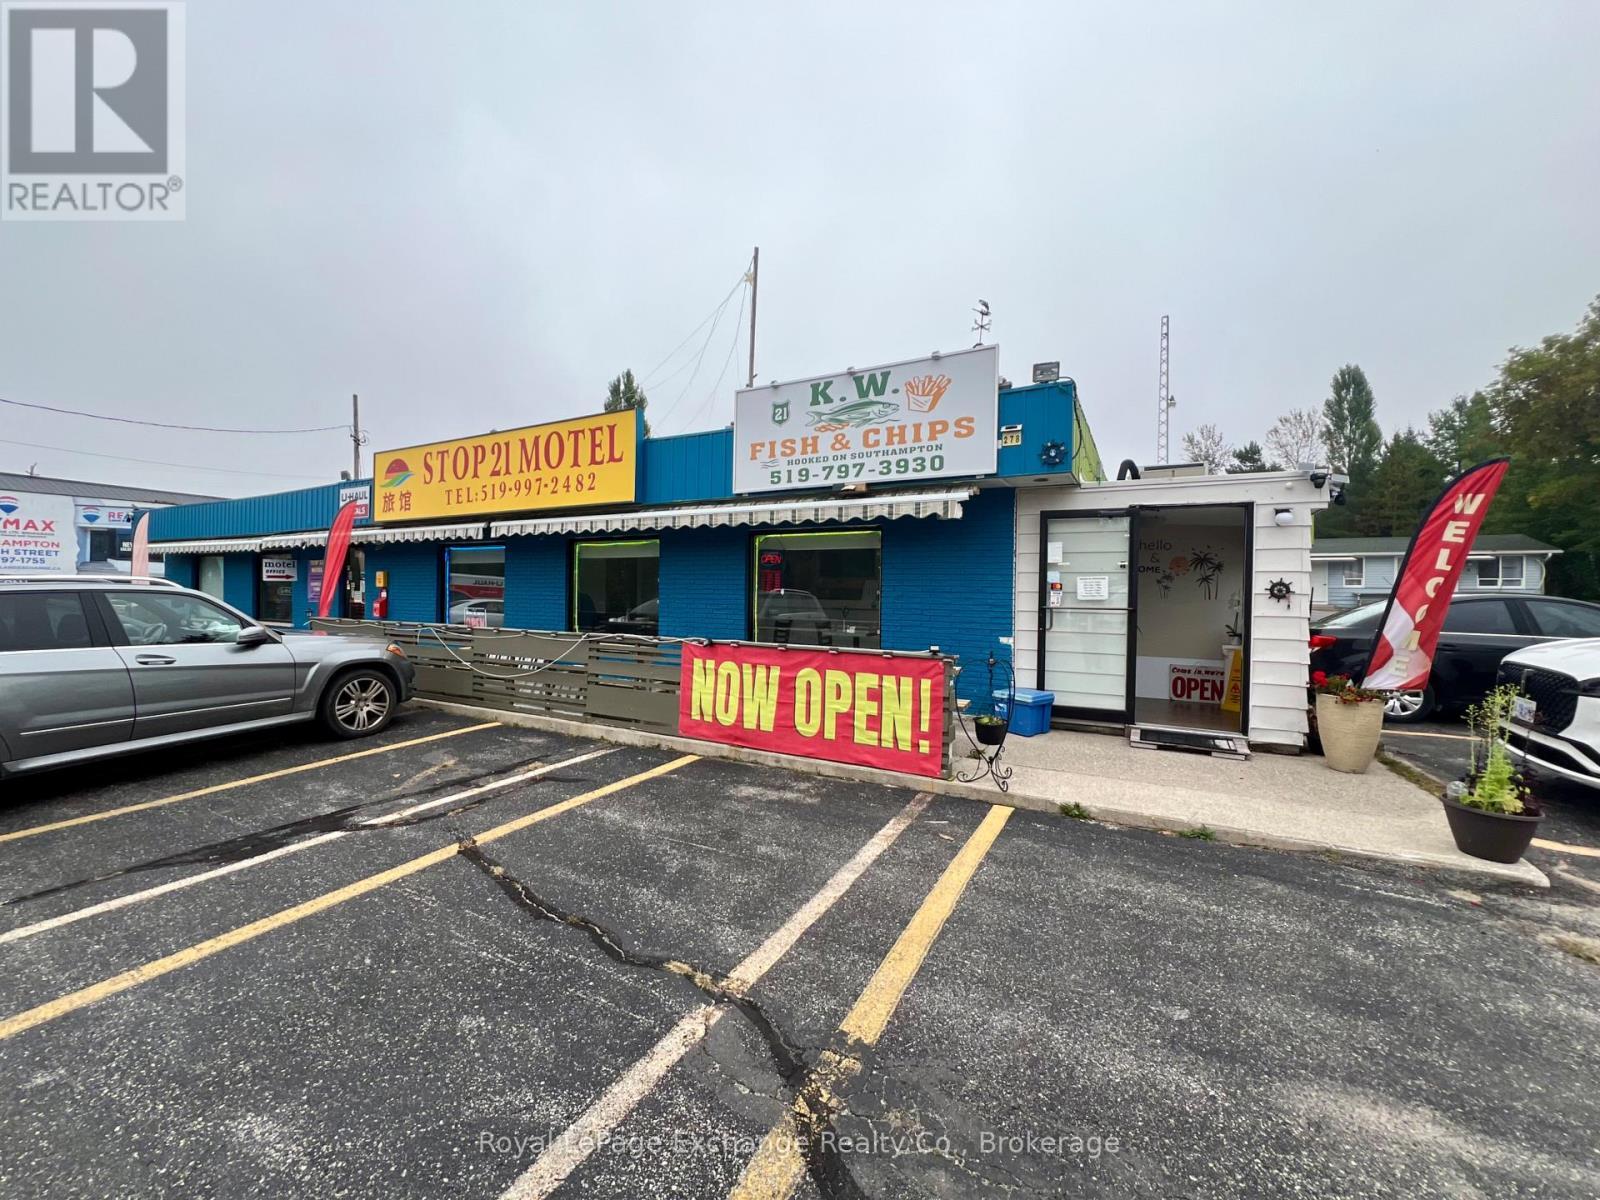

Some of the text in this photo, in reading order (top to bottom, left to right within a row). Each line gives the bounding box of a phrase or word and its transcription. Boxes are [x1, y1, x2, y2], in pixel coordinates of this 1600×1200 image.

[774, 407, 788, 421] 21
[750, 416, 976, 461] FISH & CHIPS
[1003, 434, 1020, 445] 278
[518, 423, 624, 475] MOTEL
[787, 443, 943, 466] HOOKED ON SOUTHAMPTON
[770, 454, 945, 486] 519-797-3930
[341, 490, 368, 502] U-HAUL
[382, 490, 413, 513] 旅馆
[0, 539, 60, 549] AMPTON
[1139, 538, 1173, 552] hello
[14, 548, 60, 557] STREET
[0, 556, 46, 564] 97-1755
[264, 560, 296, 568] motel
[1172, 667, 1191, 675] Come
[1172, 675, 1225, 701] OPEN
[691, 657, 932, 755] NOW OPEN!
